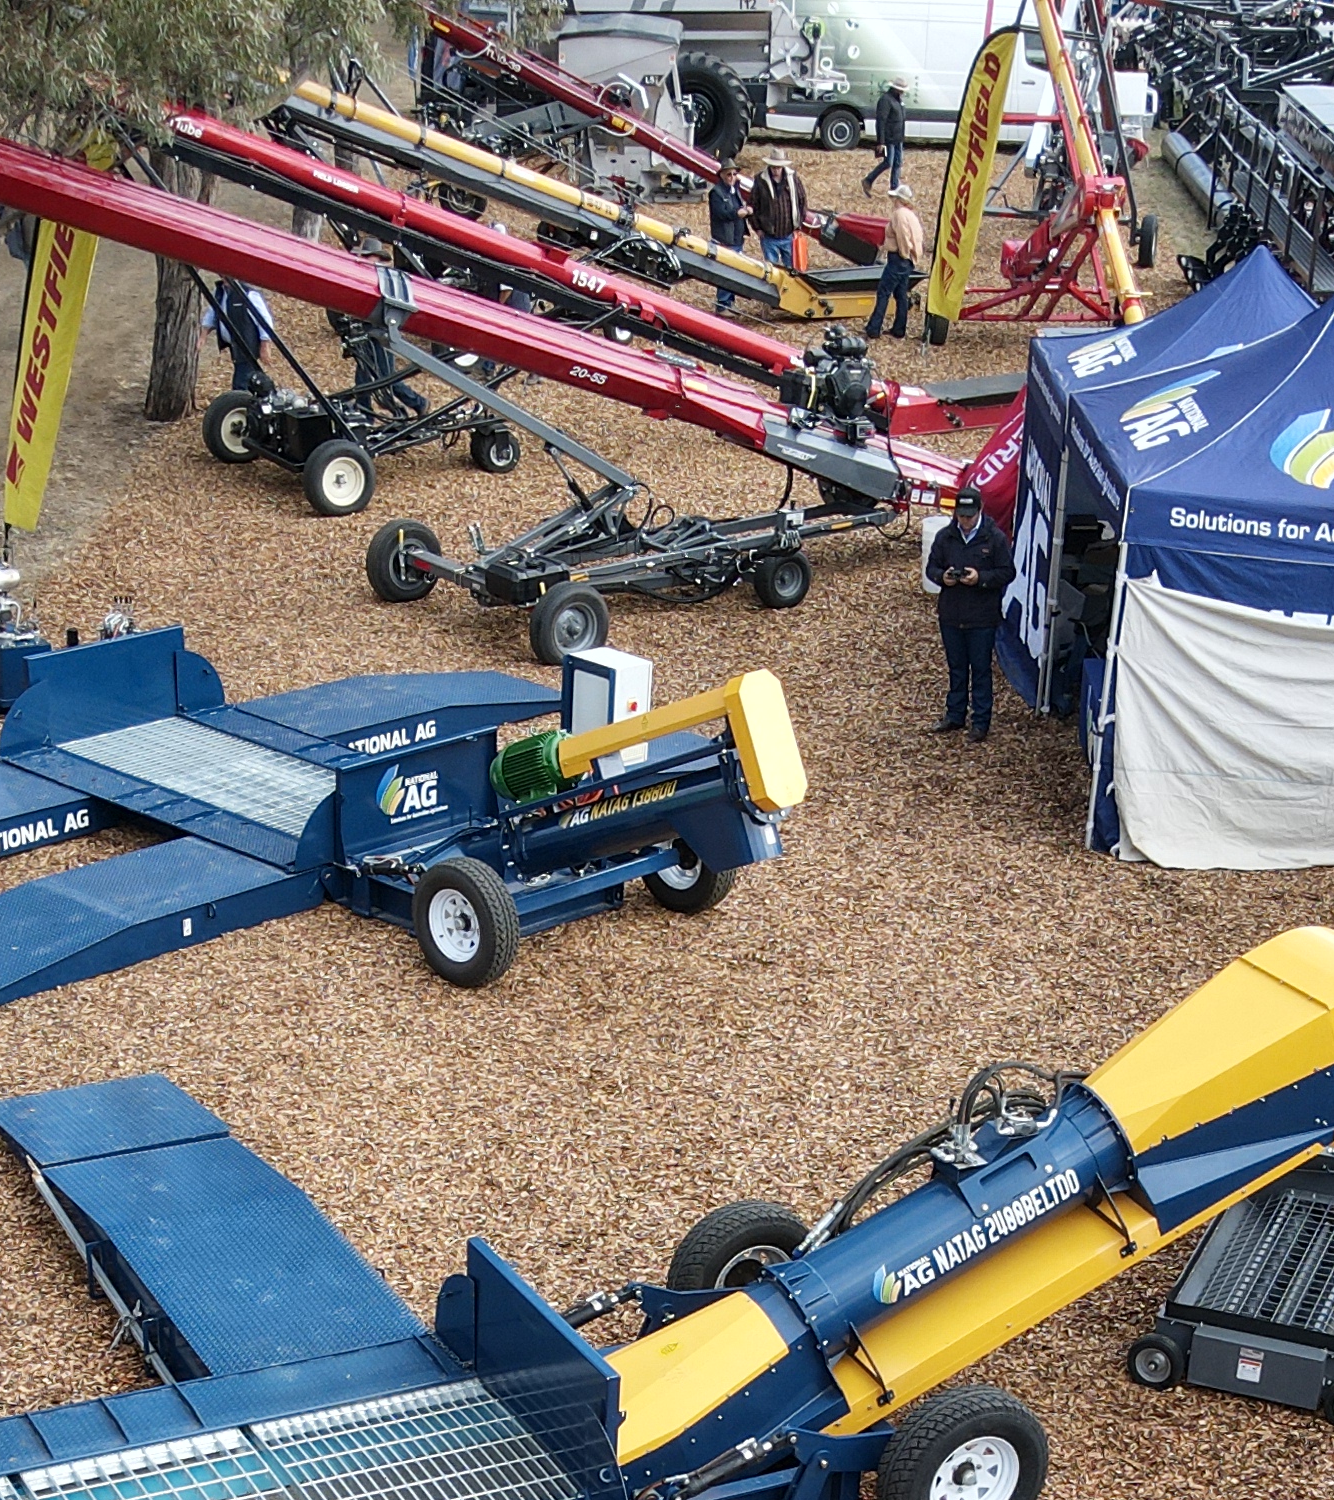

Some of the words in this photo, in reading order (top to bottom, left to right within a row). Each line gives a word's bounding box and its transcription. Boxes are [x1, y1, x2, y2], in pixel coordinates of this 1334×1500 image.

[946, 52, 1001, 259] WESTFIELD
[572, 269, 607, 294] 1547
[16, 222, 75, 444] WESTFIE
[570, 366, 608, 385] 20-55
[1067, 343, 1123, 379] AG
[1123, 408, 1192, 451] AG
[1169, 506, 1272, 537] Solutions
[1277, 518, 1311, 540] for
[348, 728, 411, 755] TIONAL
[415, 720, 437, 742] AG
[402, 780, 438, 813] AG
[64, 809, 90, 833] AG
[569, 808, 590, 828] AG
[903, 1262, 936, 1297] AG
[932, 1224, 988, 1275] NATAG
